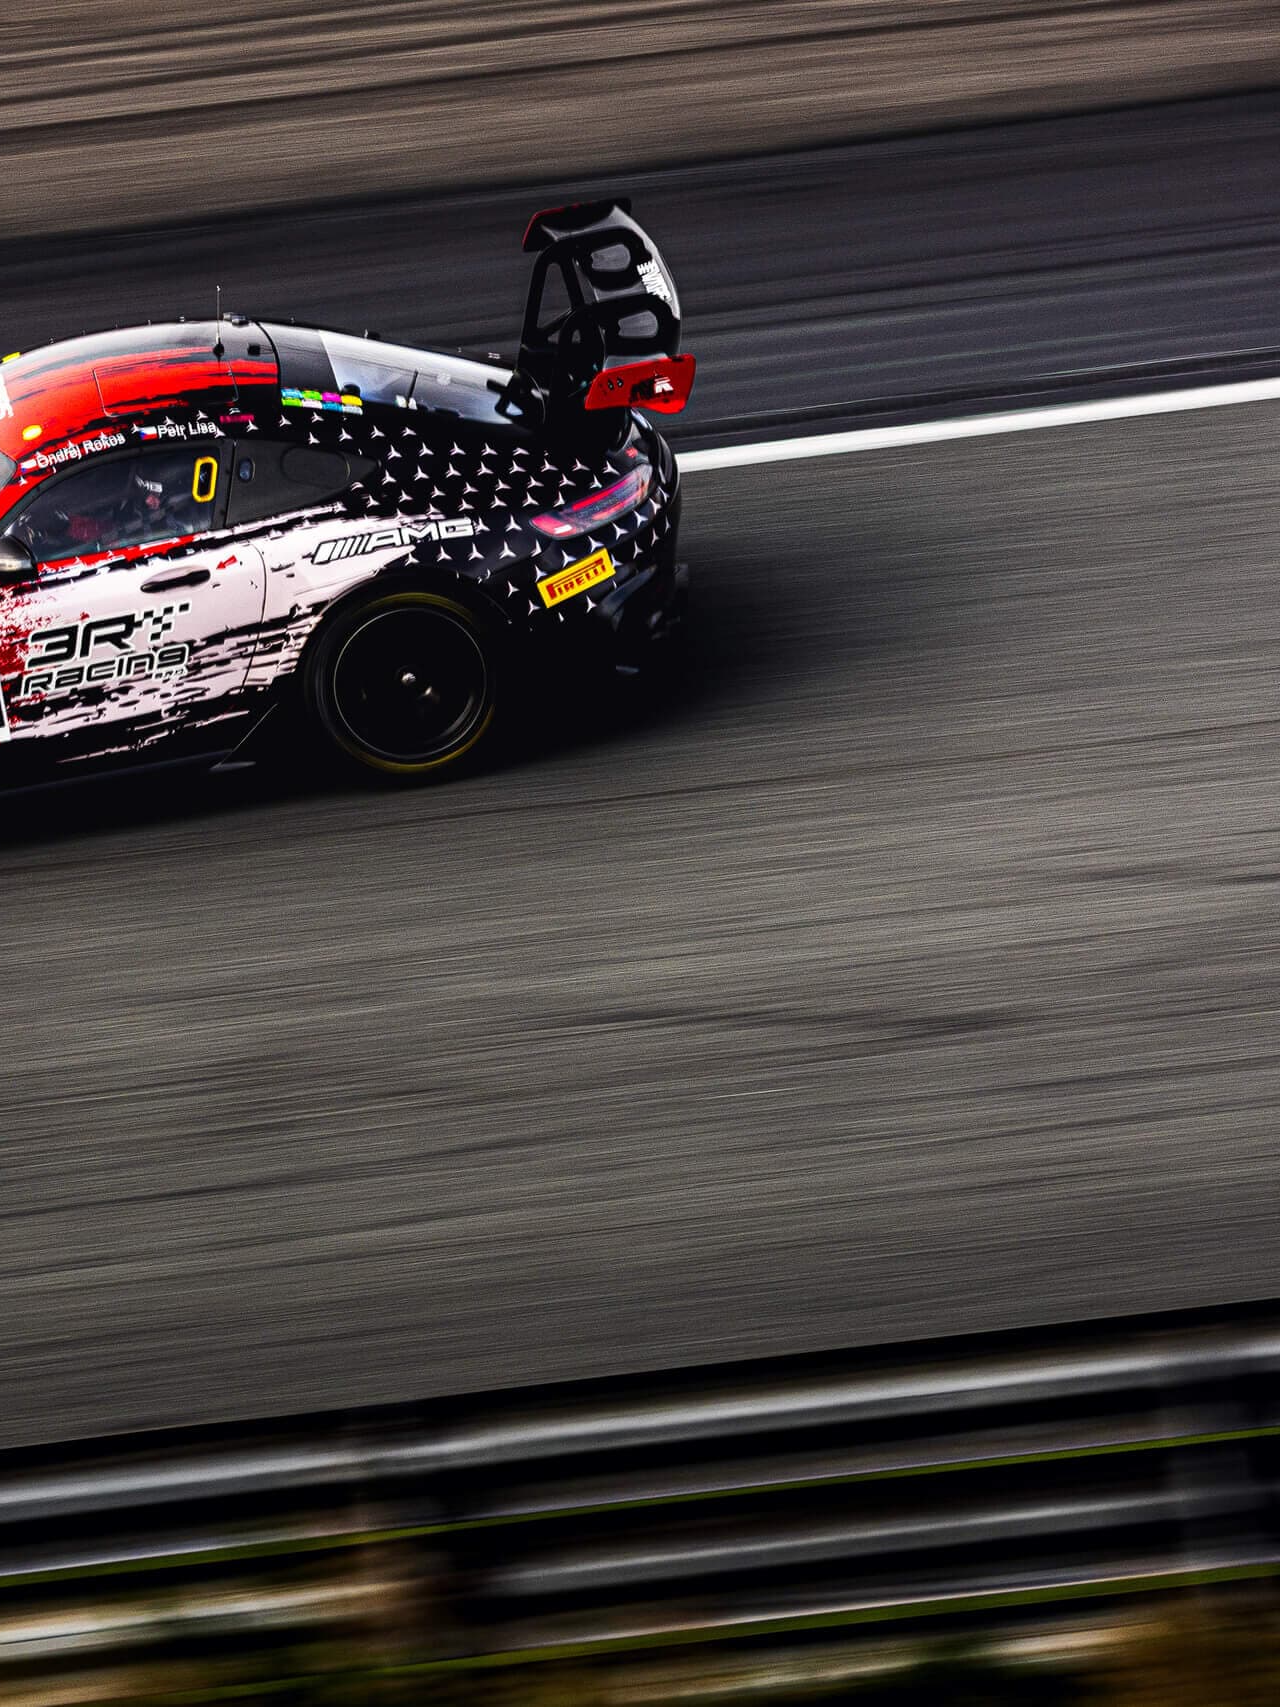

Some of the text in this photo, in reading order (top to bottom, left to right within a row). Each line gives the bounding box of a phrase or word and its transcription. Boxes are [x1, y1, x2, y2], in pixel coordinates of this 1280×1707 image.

[363, 518, 474, 553] AMG
[546, 557, 607, 600] PIRELLI
[28, 613, 136, 668] 3R
